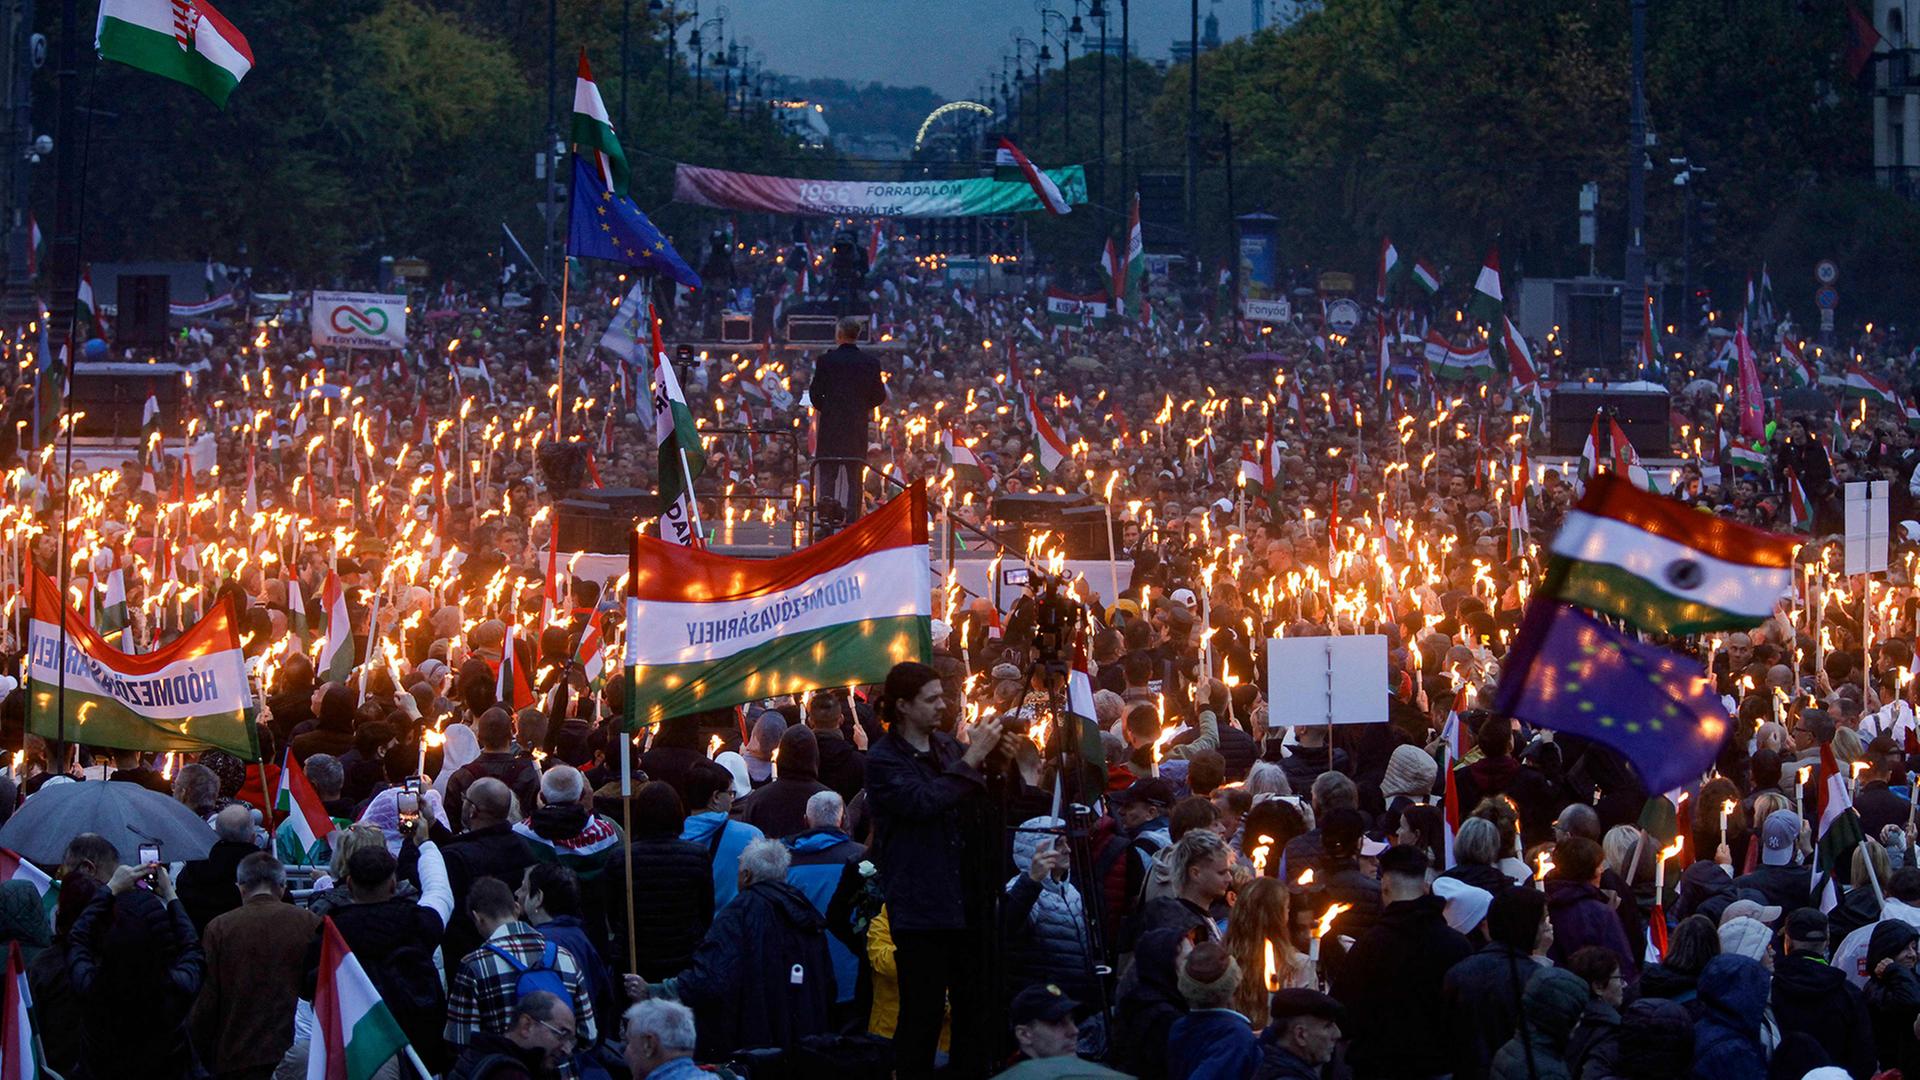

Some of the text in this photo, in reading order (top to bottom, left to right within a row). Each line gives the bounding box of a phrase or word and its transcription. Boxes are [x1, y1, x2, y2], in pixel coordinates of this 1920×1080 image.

[799, 182, 962, 203] 1956 FORRADALOM
[1248, 302, 1286, 317] Fonyód
